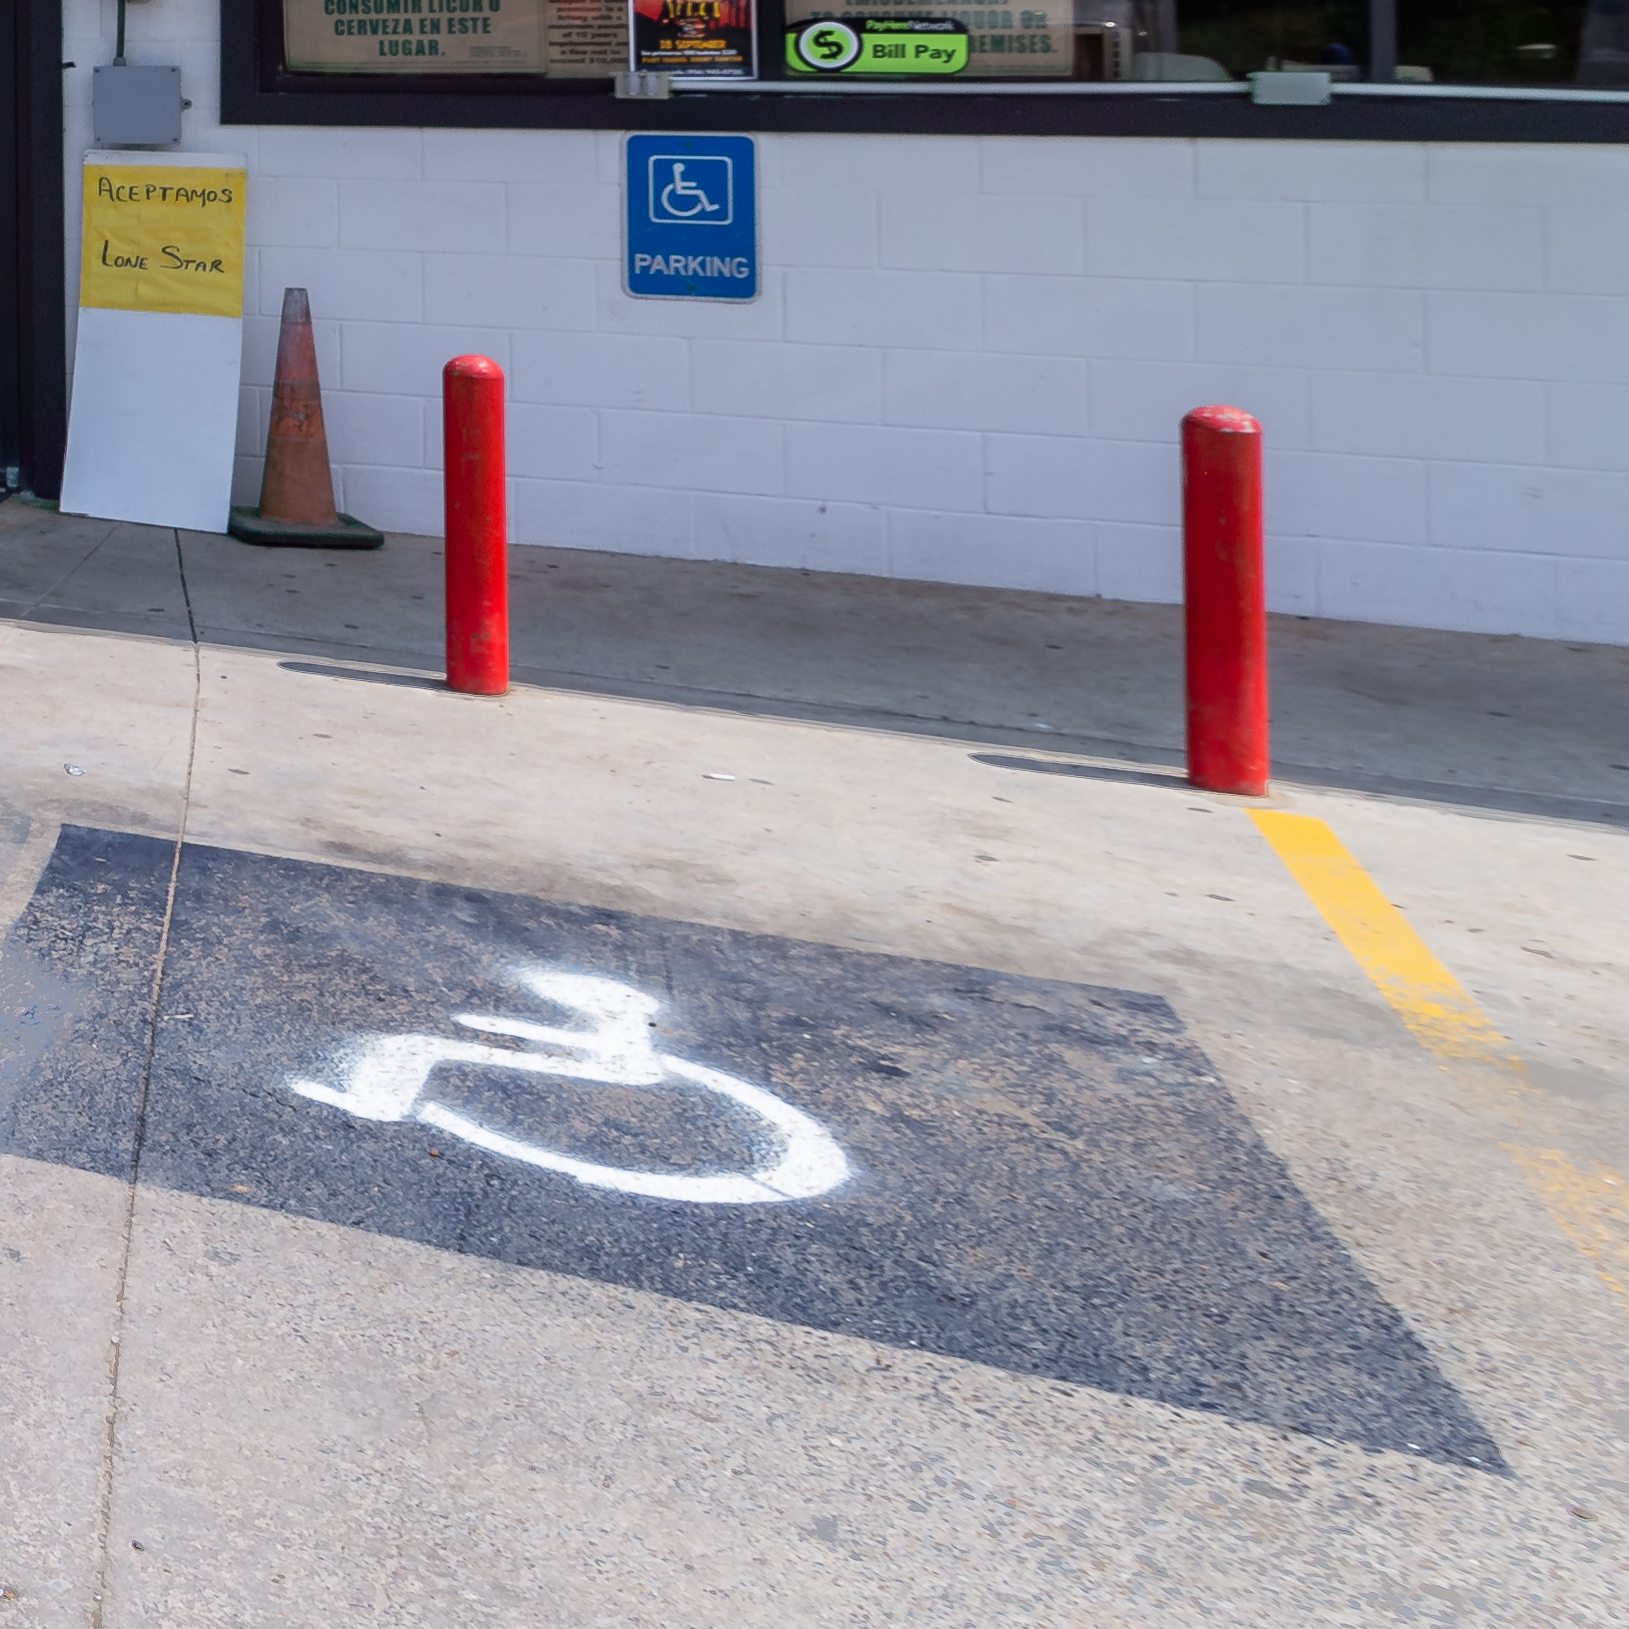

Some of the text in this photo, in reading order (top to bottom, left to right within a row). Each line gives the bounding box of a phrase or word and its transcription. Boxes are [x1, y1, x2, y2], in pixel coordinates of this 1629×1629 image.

[334, 16, 492, 36] CERVEZA EN ESTE
[379, 39, 446, 56] LUGAR.
[872, 44, 956, 63] Bill Pay
[98, 176, 233, 207] ACEPTAMOS
[101, 239, 225, 273] LONE STAR
[634, 253, 749, 279] PARKING
